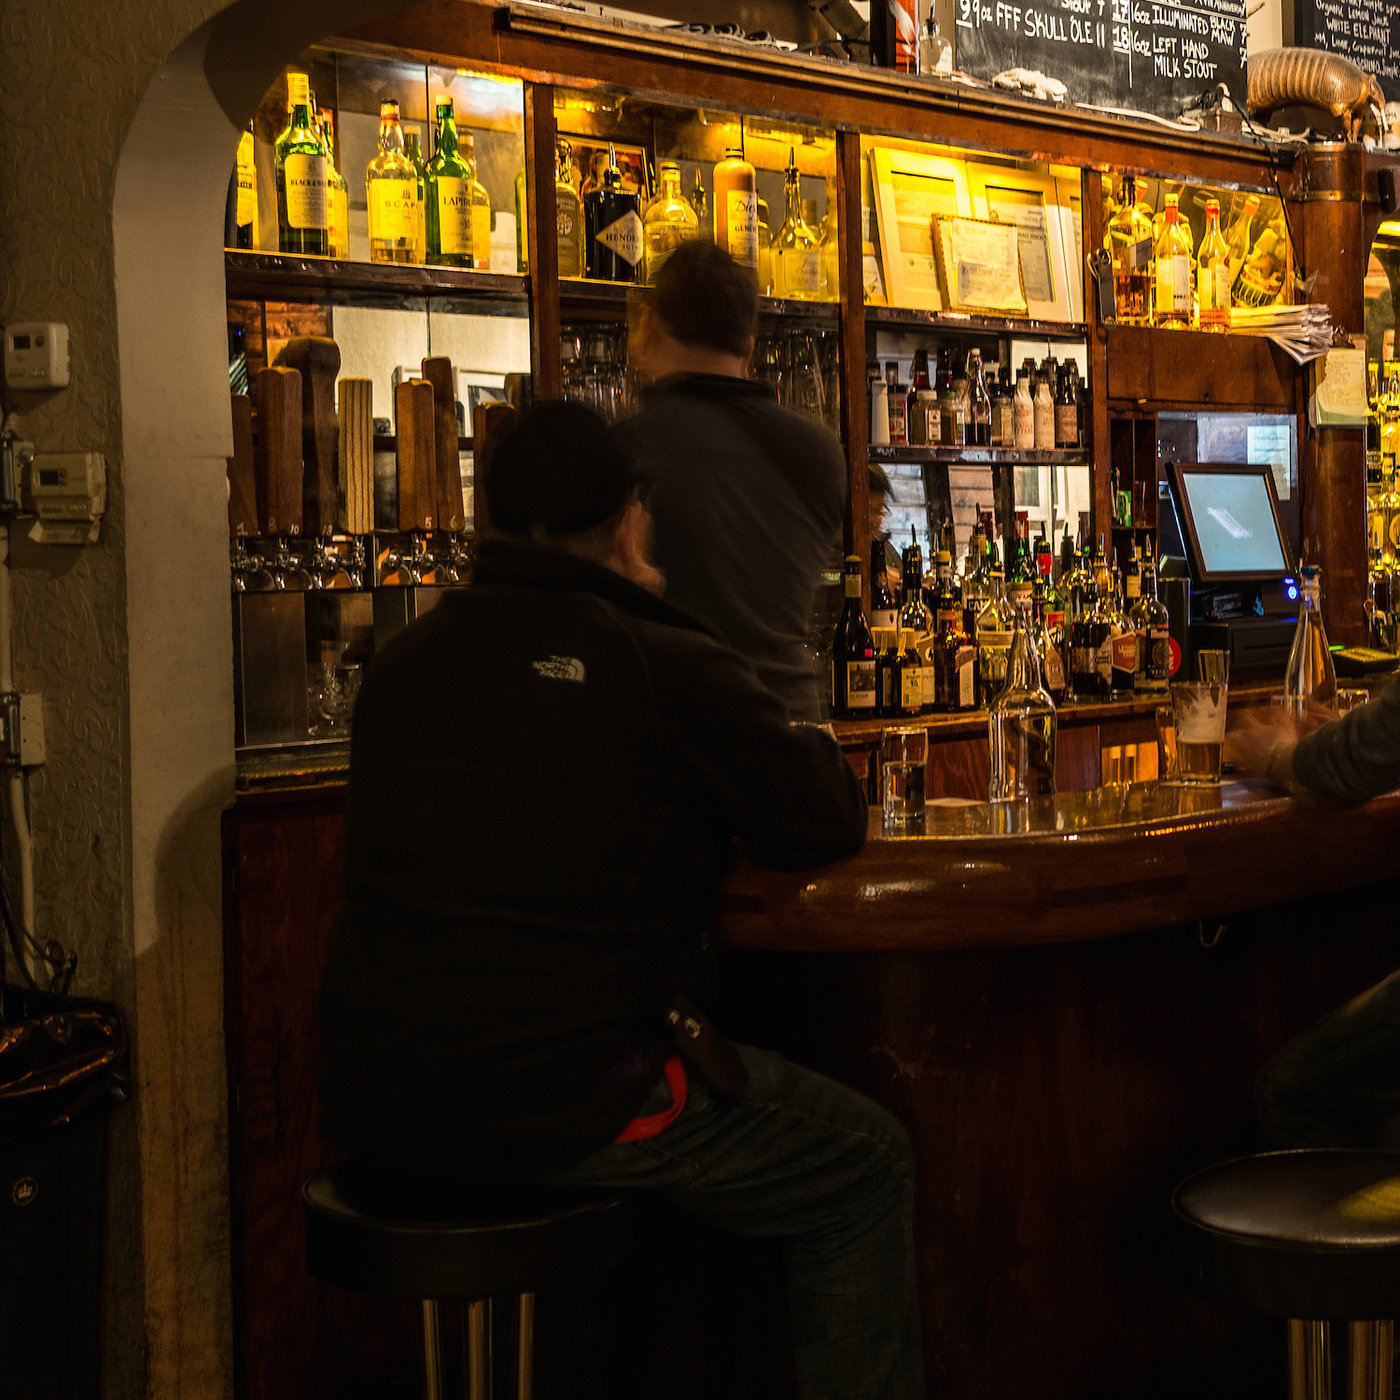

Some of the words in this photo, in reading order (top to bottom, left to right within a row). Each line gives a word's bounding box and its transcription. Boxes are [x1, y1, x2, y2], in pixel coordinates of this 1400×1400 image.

[960, 0, 970, 20] 9
[996, 1, 1021, 31] FFF
[1024, 8, 1067, 41] SKULL
[1152, 5, 1209, 35] ILLUMINATED
[1210, 16, 1236, 33] BLACK
[1353, 22, 1391, 45] ELEPHANT
[1112, 26, 1128, 49] 18
[1153, 33, 1177, 54] LEFT
[1181, 38, 1209, 60] HAND
[1211, 29, 1235, 46] MAW
[1155, 55, 1181, 77] MILK
[1183, 58, 1217, 79] STOUT
